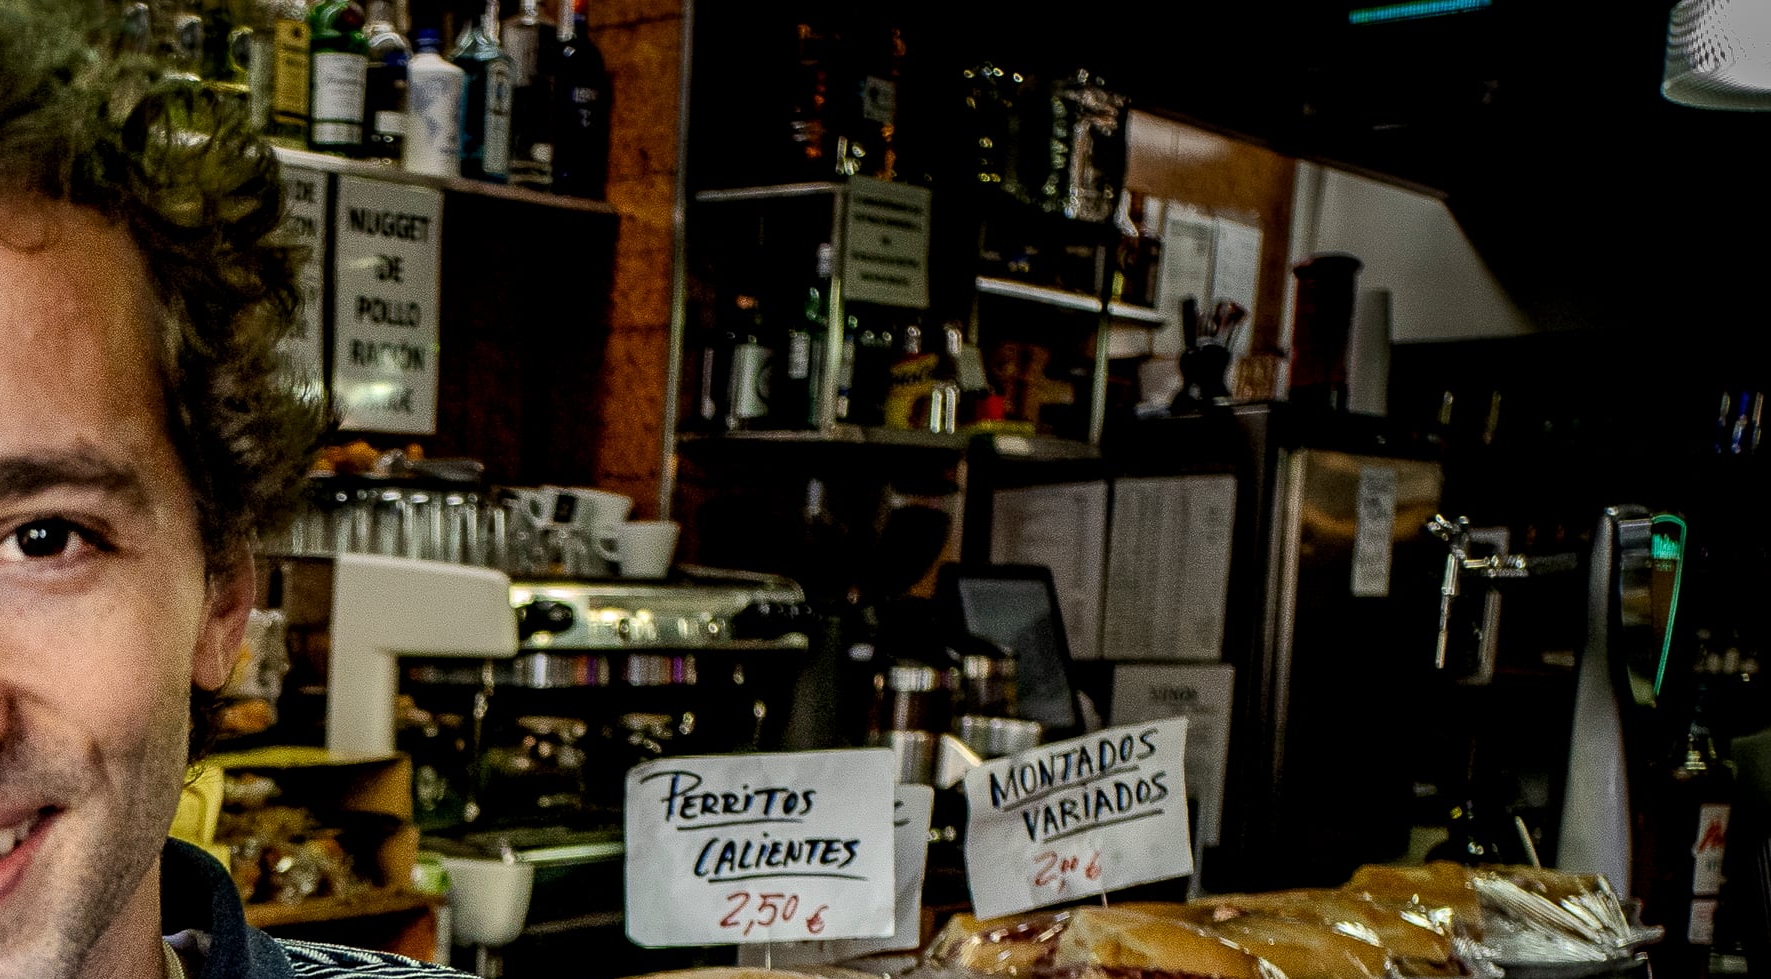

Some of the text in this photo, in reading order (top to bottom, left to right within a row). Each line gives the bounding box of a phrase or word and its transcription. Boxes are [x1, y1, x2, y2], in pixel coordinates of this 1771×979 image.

[348, 206, 430, 244] NUGGET
[375, 254, 404, 283] DE
[354, 295, 421, 328] POLLO
[989, 727, 1159, 809] MONTADOS
[1022, 770, 1169, 843] VARIADOS
[693, 832, 861, 877] CALIENTES
[719, 890, 801, 937] 2,50
